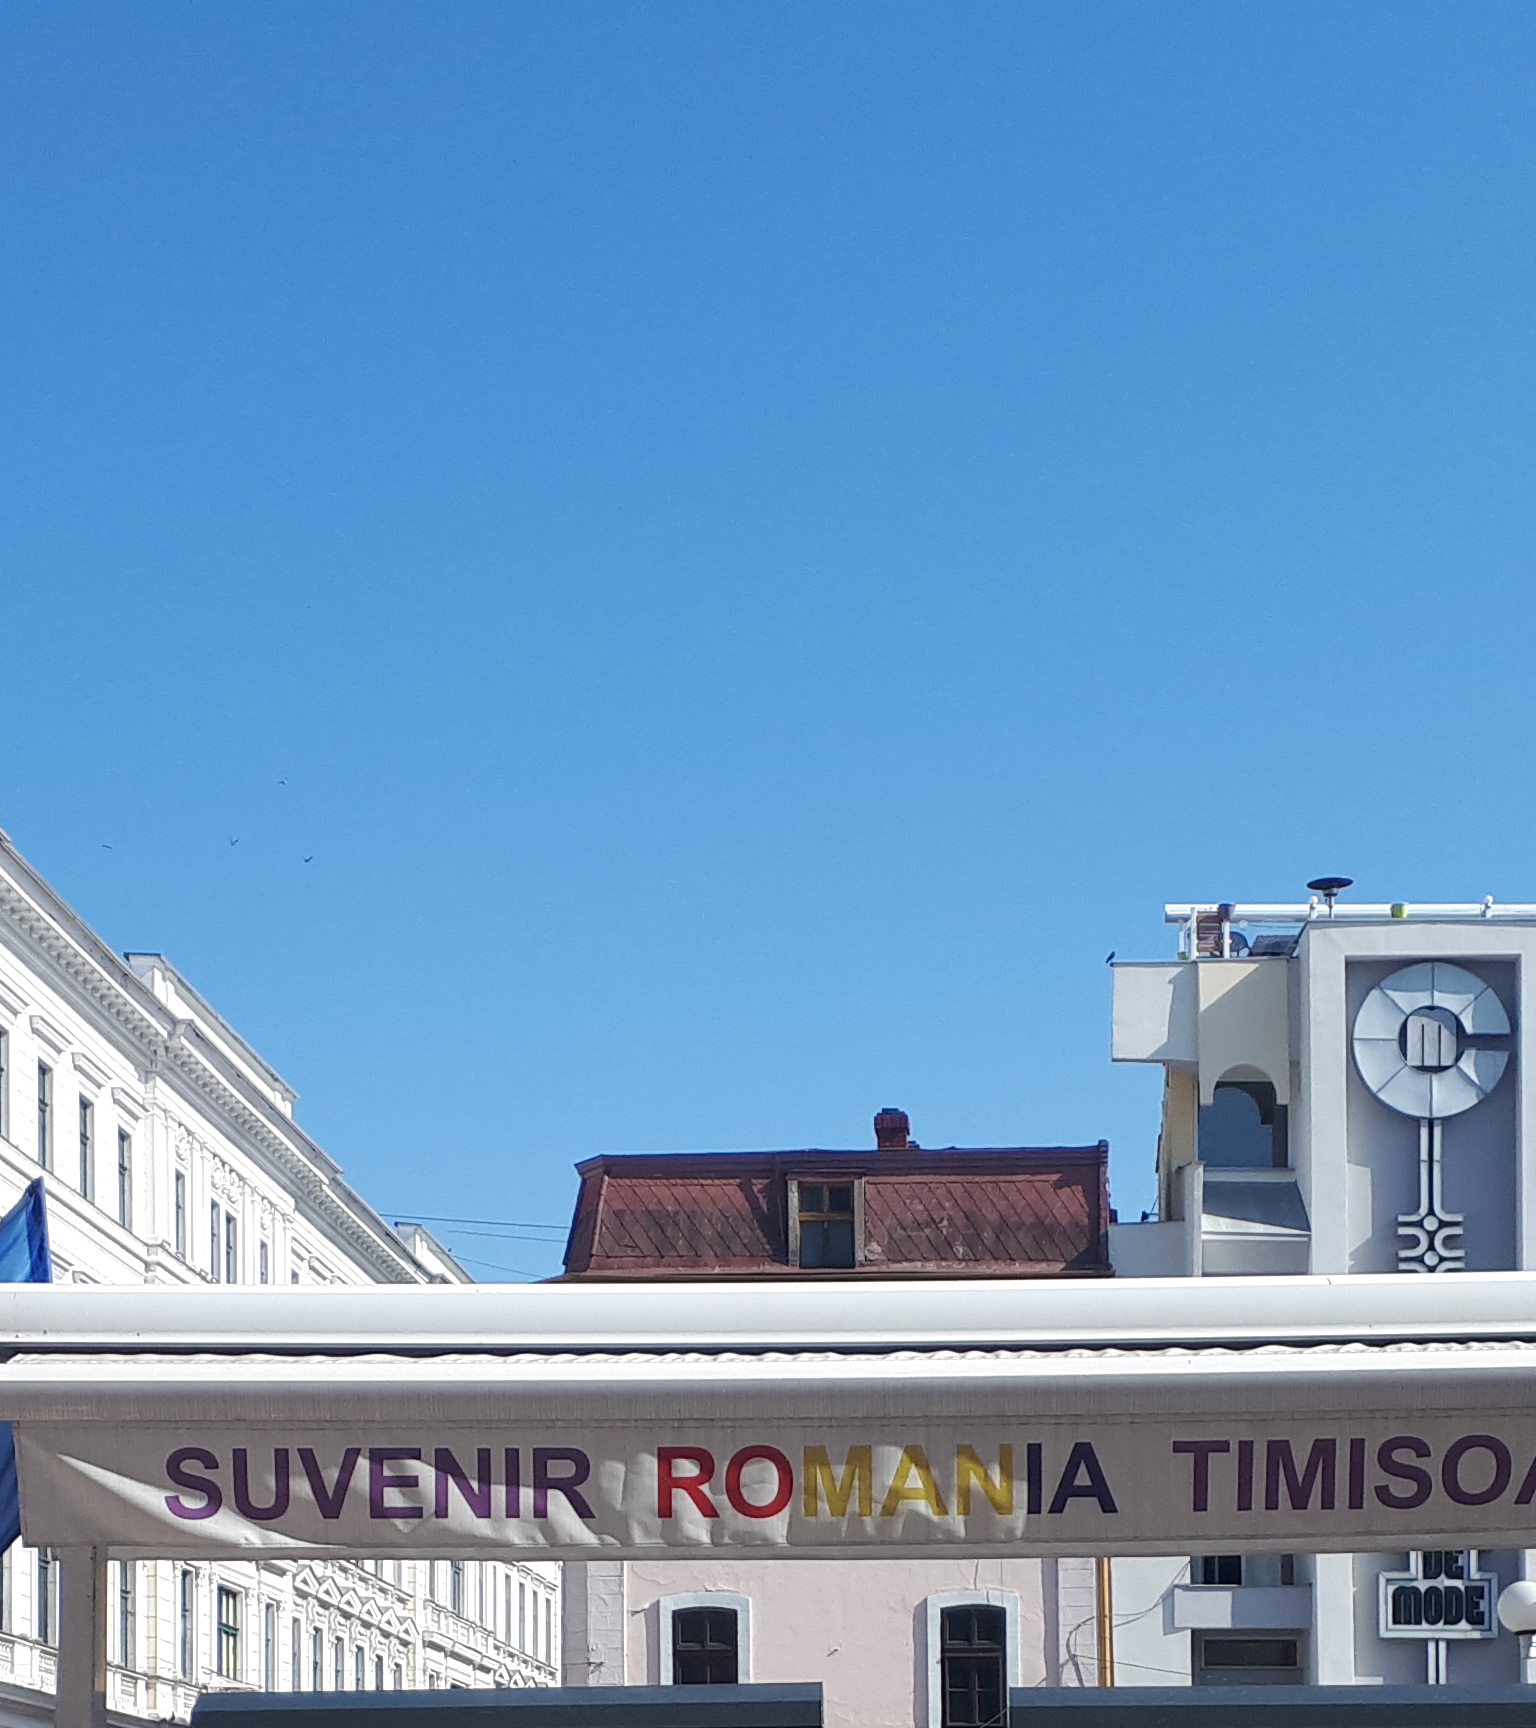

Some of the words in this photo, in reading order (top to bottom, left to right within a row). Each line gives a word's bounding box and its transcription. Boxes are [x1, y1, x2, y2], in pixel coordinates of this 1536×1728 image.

[165, 1444, 595, 1521] SUVENIR
[655, 1441, 1120, 1521] ROMANIA
[1423, 1551, 1463, 1580] DE
[1392, 1586, 1484, 1625] MODE
